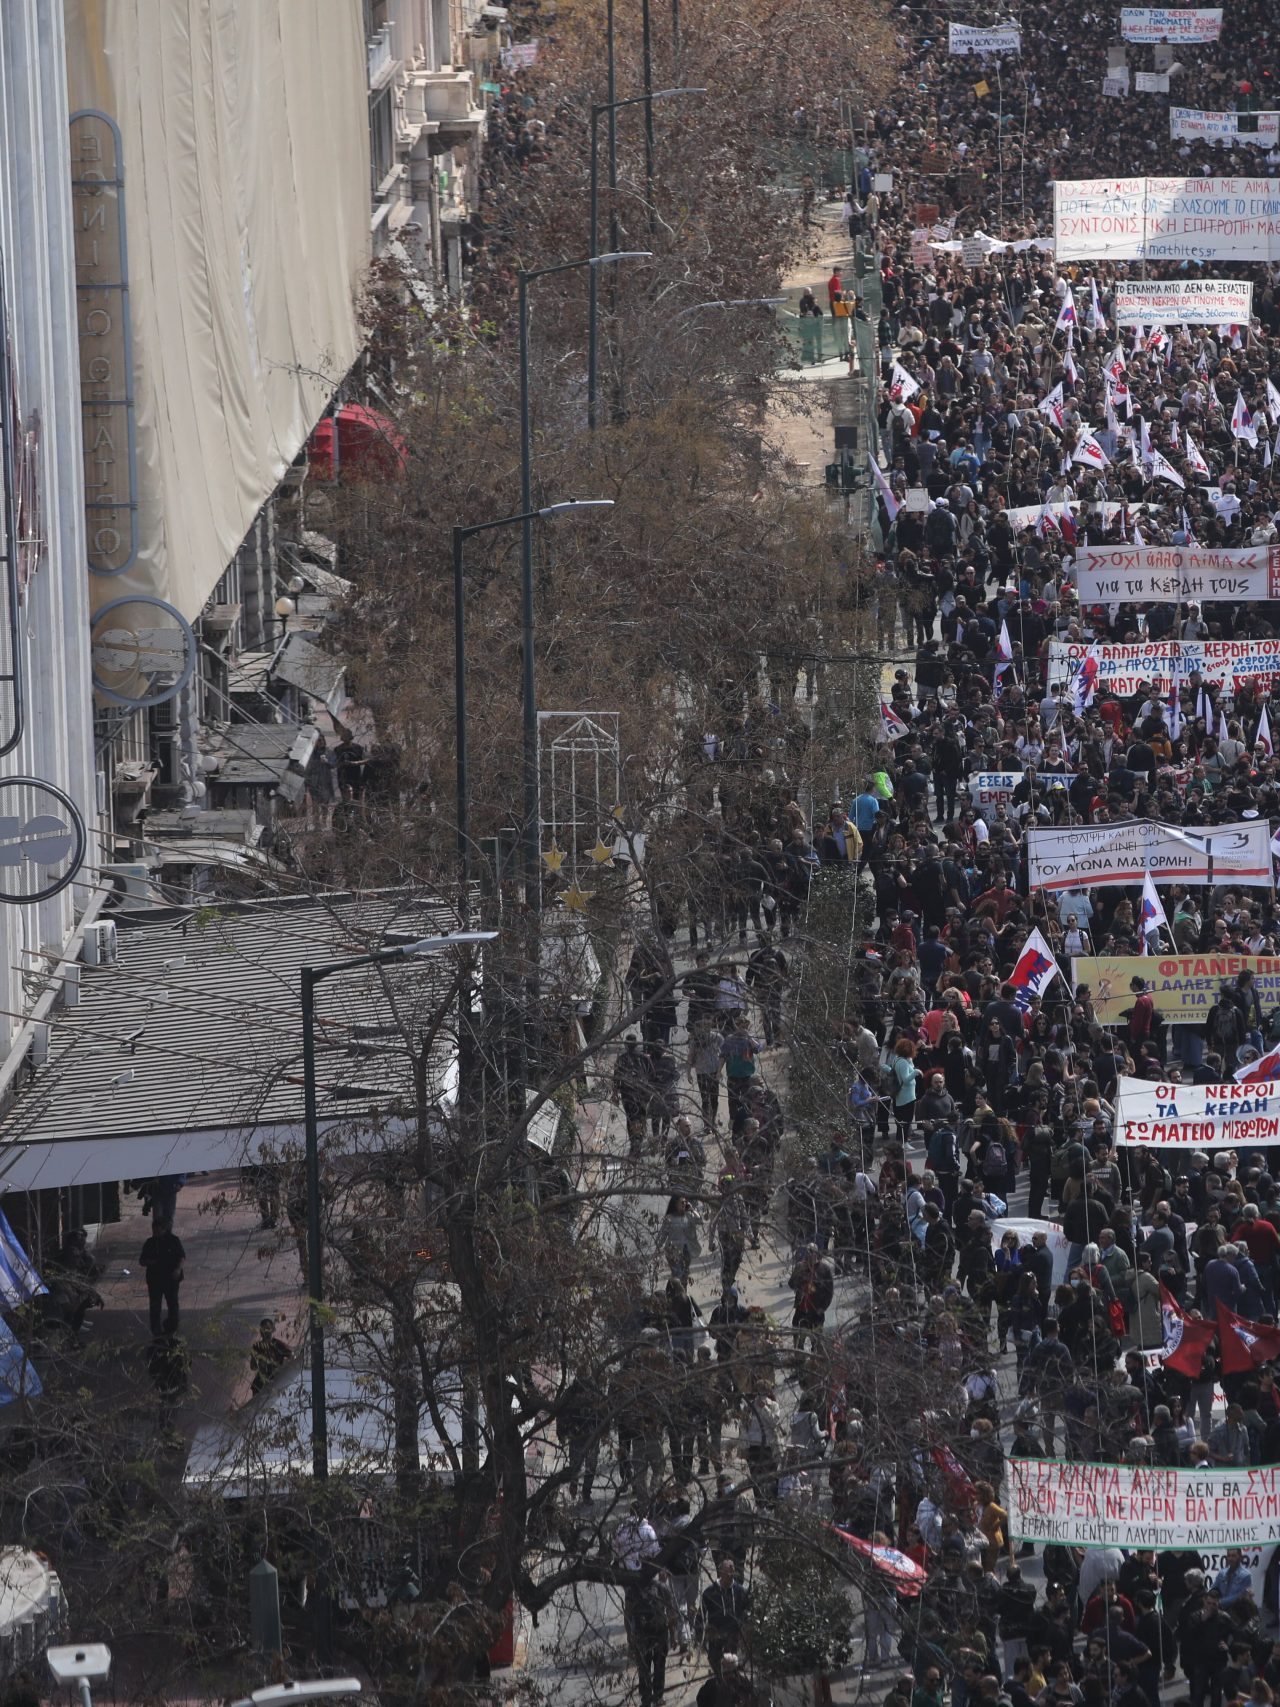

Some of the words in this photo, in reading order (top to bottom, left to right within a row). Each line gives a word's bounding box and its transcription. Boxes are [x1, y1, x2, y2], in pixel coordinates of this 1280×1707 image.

[1186, 179, 1214, 194] ΕΙΝΑΙ
[1222, 181, 1239, 194] ΜΕ
[1244, 181, 1271, 194] ΑΙΜΑ
[1061, 200, 1092, 214] ΠΟΤΕ
[1102, 199, 1130, 213] ΔΕΝ
[1235, 200, 1246, 215] ΤΟ
[1060, 217, 1177, 237] ΣΥΝΤΟΝΙΣΤΙΚΗ
[1184, 217, 1250, 237] ΕΠΙΤΡΟΠΗ
[1127, 284, 1162, 295] ΕΓΚΛΗΜΑ
[1164, 283, 1180, 294] ΑΥΤΟ
[1184, 283, 1202, 294] ΔΕΝ
[1205, 282, 1216, 293] ΘΑ
[1217, 283, 1249, 295] ΞΕΧΑΣΤΕΙ
[1152, 297, 1179, 307] ΝΕΚΡΩΝ
[1182, 296, 1192, 306] ΘΑ
[1194, 296, 1225, 306] ΓΙΝΟΥΜΕ
[1096, 579, 1118, 597] για
[1126, 580, 1143, 595] τα
[1103, 645, 1140, 660] ΑΛΛΗ
[1144, 641, 1181, 657] ΘΥΣΙΑ
[1204, 641, 1249, 658] ΚΕΡΔΗ
[1126, 656, 1204, 675] ΠΡΟΣΤΑΣΙΑΣ
[1236, 655, 1280, 666] ΧΩΡΟΥΣ
[979, 775, 1014, 788] ΕΣΕΙΣ
[1057, 835, 1064, 845] Η
[1068, 832, 1105, 845] ΘΛΙΨΗ
[1109, 828, 1124, 839] ΚΑΙ
[1128, 828, 1135, 838] Η
[1088, 845, 1106, 856] ΝΑ
[1110, 841, 1137, 853] ΓΙΝΕΙ
[1037, 864, 1061, 876] ΤΟΥ
[1066, 857, 1112, 873] ΑΓΩΝΑ
[1117, 856, 1146, 869] ΜΑΣ
[1149, 856, 1192, 867] ΟΡΜΗ!
[1159, 958, 1247, 978] ΦΤΑΝΕΙ
[1172, 978, 1214, 992] ΑΛΛΕΣ
[1182, 992, 1207, 1006] ΓΙΑ
[1156, 1085, 1176, 1101] ΟΙ
[1206, 1083, 1274, 1100] ΝΕΚΡΟΙ
[1156, 1103, 1179, 1118] ΤΑ
[1205, 1097, 1268, 1116] ΚΕΡΔΗ
[1125, 1121, 1215, 1143] ΣΩΜΑΤΕΙΟ
[1222, 1117, 1279, 1140] ΜΙΣΘΩΤΩΝ
[1037, 1461, 1121, 1495] ΕΓΚΛΗΜΑ
[1131, 1468, 1178, 1498] ΑΥΤΟ
[1186, 1482, 1213, 1498] ΔΕΝ
[1222, 1482, 1241, 1497] ΘΑ
[1065, 1491, 1097, 1519] ΤΩΝ
[1106, 1494, 1175, 1522] ΝΕΚΡΩΝ
[1186, 1498, 1208, 1522] ΘΑ
[1022, 1517, 1069, 1539] ΕΡΓΑΤΙΚΟ
[1075, 1523, 1119, 1544] ΚΕΝΤΡΟ
[1187, 1526, 1259, 1546] ΑΝΑΤΟΛΙΚΗΣ
